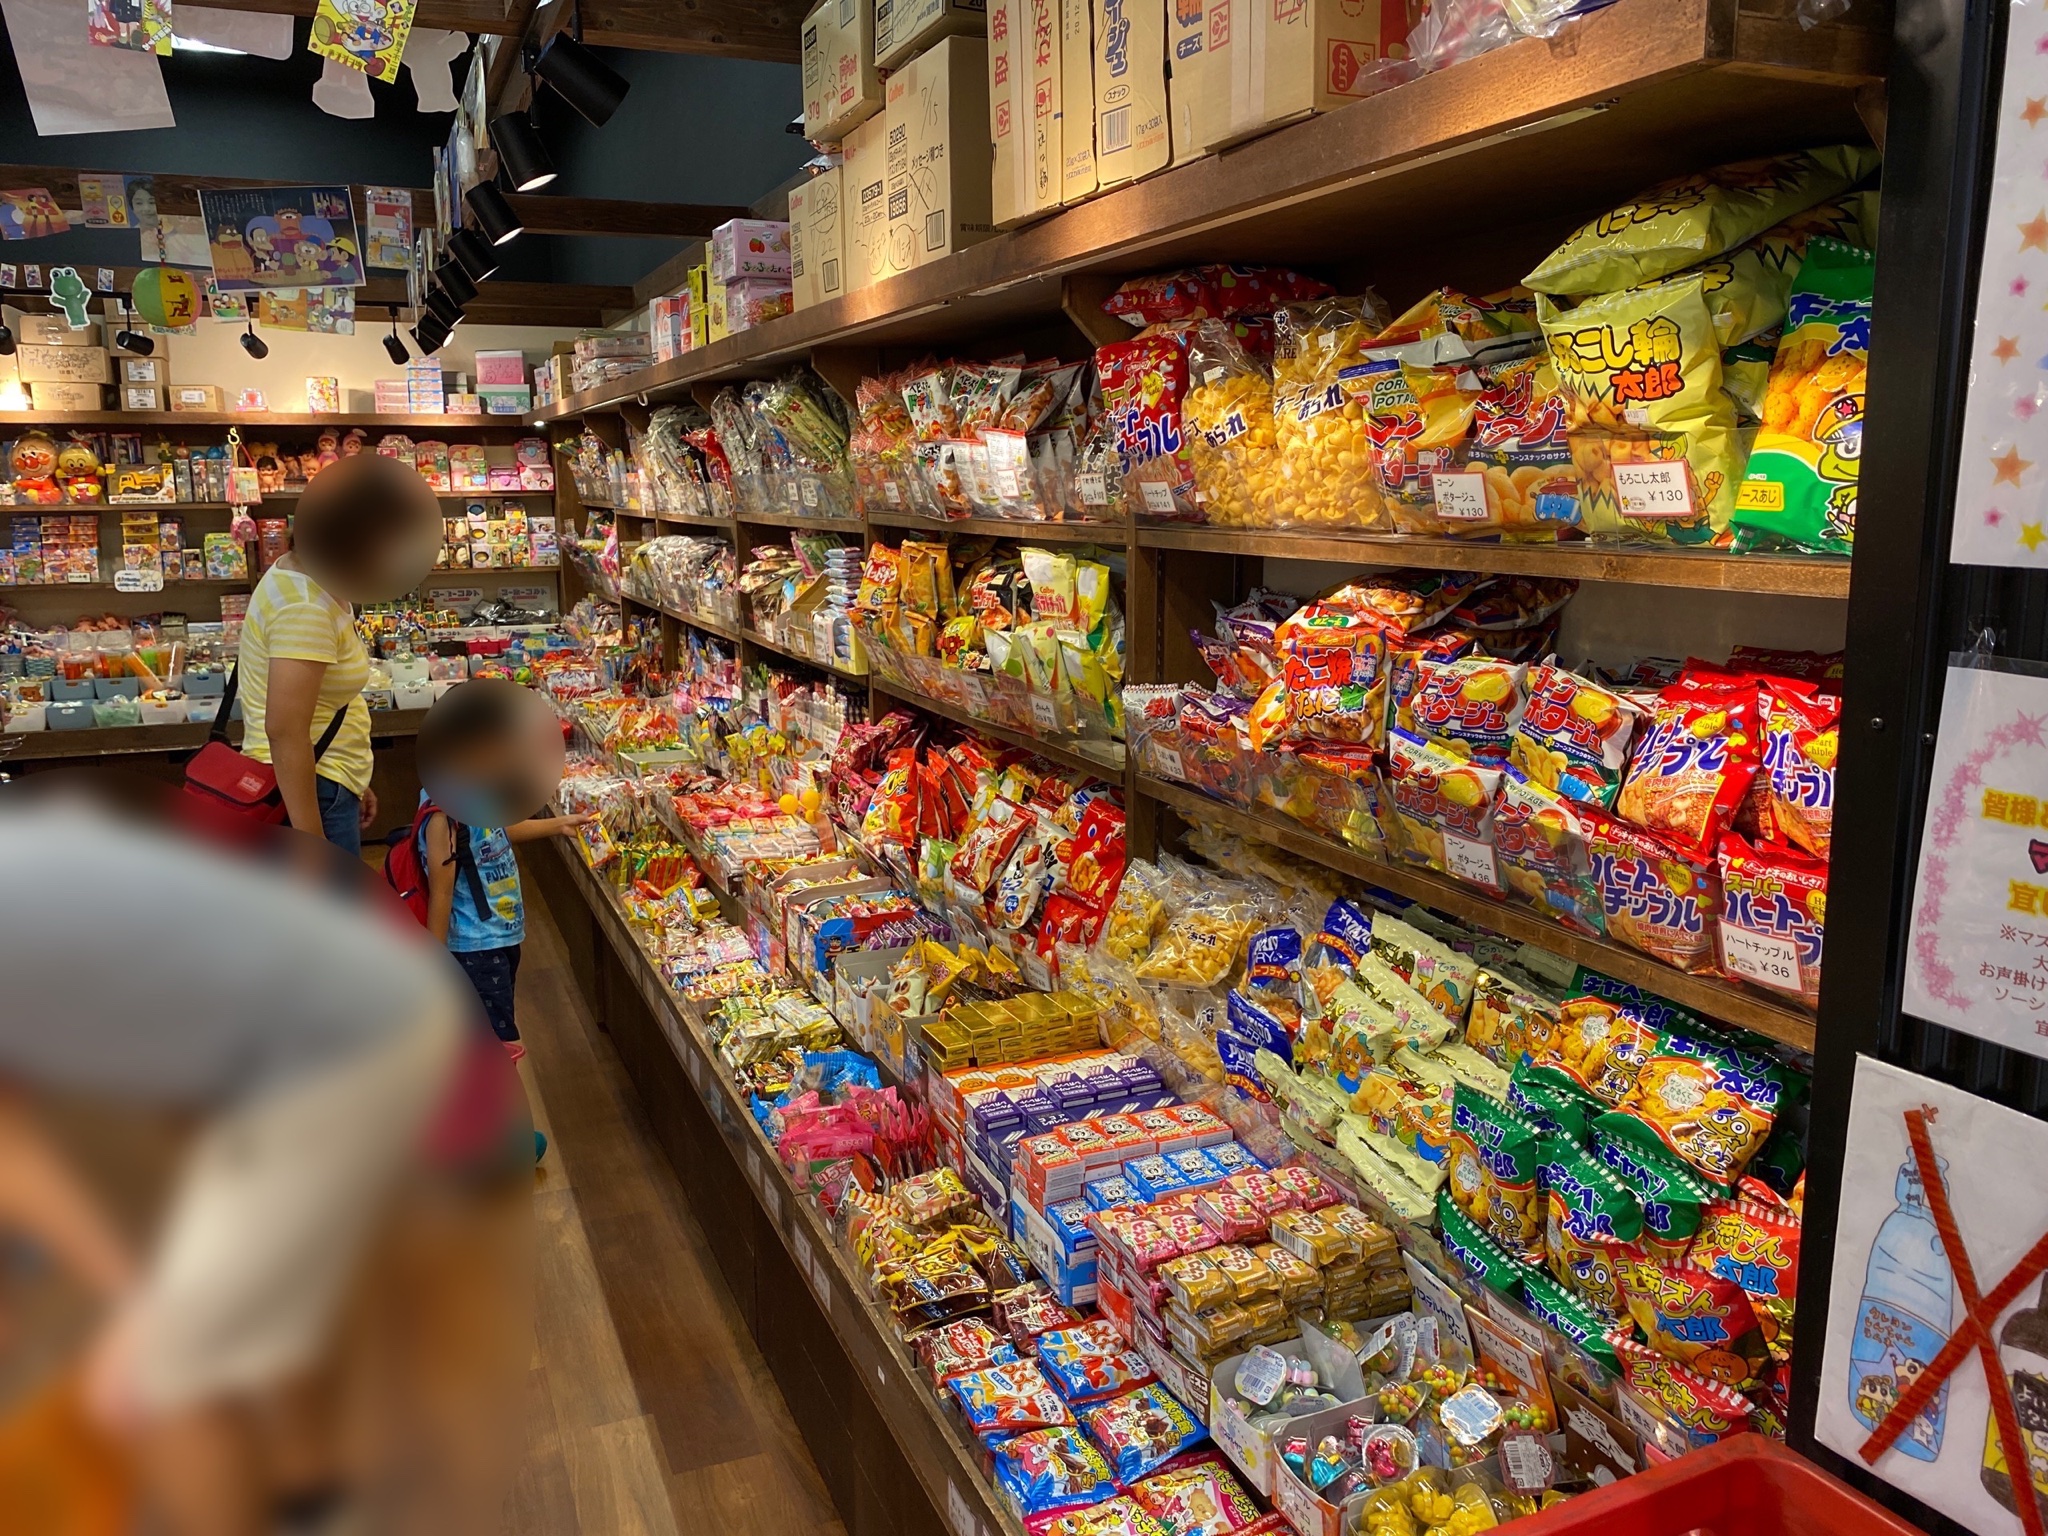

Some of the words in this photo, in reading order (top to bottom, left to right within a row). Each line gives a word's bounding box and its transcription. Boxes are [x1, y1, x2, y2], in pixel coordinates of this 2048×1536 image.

[1339, 48, 1348, 89] リスカ
[1107, 88, 1126, 100] スナック
[1611, 364, 1684, 403] 太郎
[1297, 380, 1344, 422] あられ
[1203, 409, 1248, 449] あられ
[1436, 478, 1454, 488] コーン
[1618, 472, 1671, 485] もろこし太郎
[1442, 491, 1476, 503] ポタージュ
[1459, 507, 1484, 517] ¥130
[1648, 489, 1683, 502] ¥130
[1285, 647, 1353, 691] たこ焼
[1524, 696, 1605, 756] ポタージュ
[1447, 837, 1465, 850] コーン
[1590, 838, 1642, 861] スーパー
[1456, 853, 1492, 871] ポタージュ
[1471, 871, 1490, 883] ¥36
[1590, 853, 1658, 894] ハート
[1725, 872, 1783, 899] スーパー
[1604, 885, 1703, 933] チップル
[1725, 891, 1804, 932] ハート
[1726, 934, 1795, 961] ハートチップル
[1760, 960, 1790, 978] ¥36
[1979, 961, 2048, 993] お声掛け
[1711, 1067, 1784, 1104] 太郎
[1453, 1102, 1506, 1147] キャベツ
[1478, 1144, 1520, 1179] 太郎
[1602, 1143, 1669, 1197] キャベツ
[1715, 1255, 1780, 1296] 太郎
[1488, 1302, 1542, 1349] キャベツ太郎
[1654, 1308, 1730, 1342] 太郎
[1869, 1306, 1912, 1331] クレヨン
[1187, 1371, 1208, 1392] ビスコ
